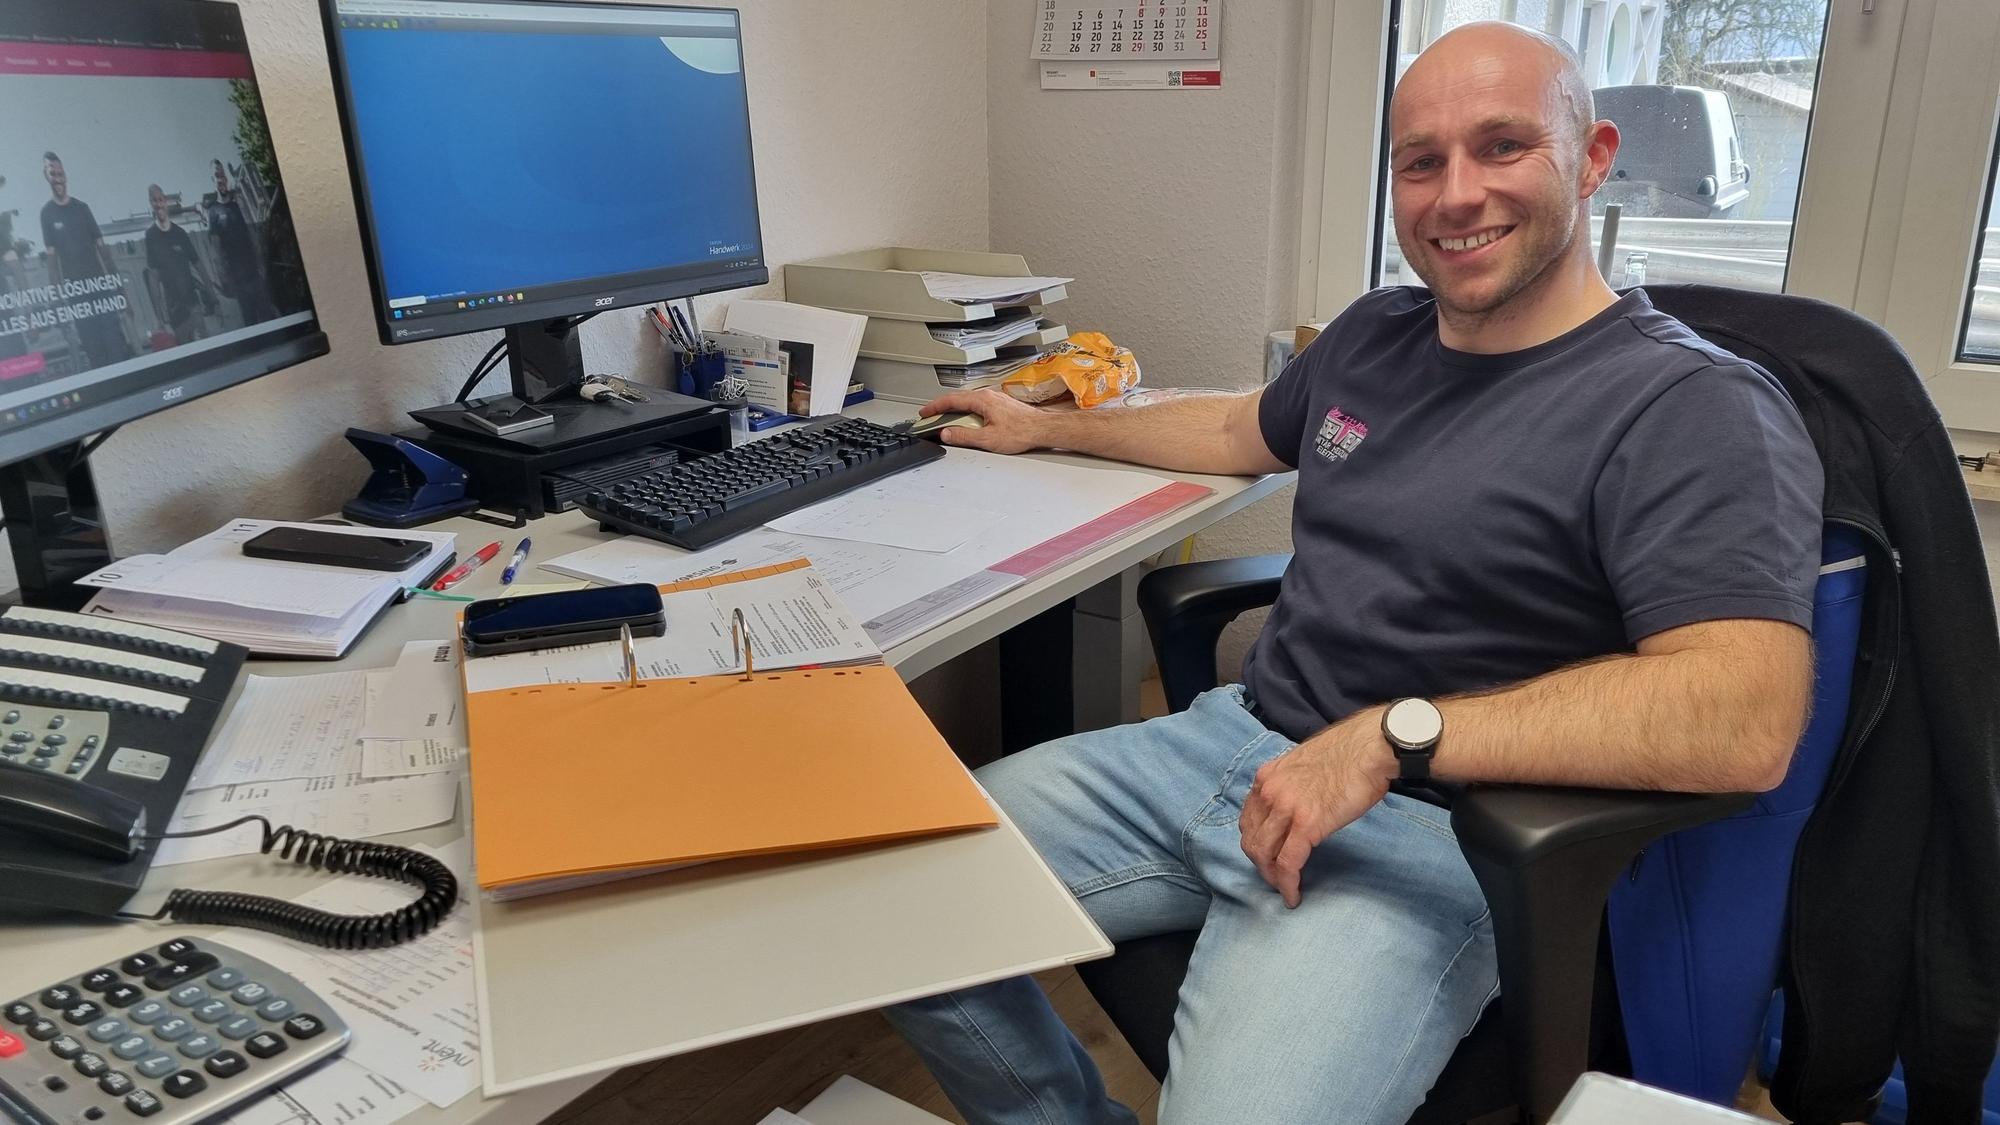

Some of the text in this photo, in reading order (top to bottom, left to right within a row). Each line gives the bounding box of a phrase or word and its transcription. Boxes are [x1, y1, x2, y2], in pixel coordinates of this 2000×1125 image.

[1045, 1, 1056, 10] 18
[1045, 6, 1208, 20] 19 5 6 7 8 9 10 11
[1043, 18, 1208, 31] 20 12 13 14 15 16 17 18
[1041, 30, 1207, 42] 21 19 20 21 22 23 24 25
[1040, 41, 1207, 53] 22 26 27 28 29 30 31 1
[57, 272, 122, 300] LÖSUNGEN
[595, 296, 615, 307] acer
[30, 310, 58, 330] AUS
[56, 302, 94, 323] EINER
[94, 294, 128, 315] HAND
[162, 385, 184, 400] acer
[232, 523, 258, 532] 11
[90, 573, 122, 583] 10
[90, 604, 114, 613] 7
[178, 985, 201, 999] 3
[202, 1000, 226, 1014] 2
[266, 999, 289, 1012] 0
[161, 1019, 186, 1032] 5
[228, 1017, 249, 1029] 1
[119, 1036, 145, 1050] 8
[186, 1035, 209, 1048] 4
[421, 1037, 474, 1068] nvent
[143, 1055, 171, 1069] 7
